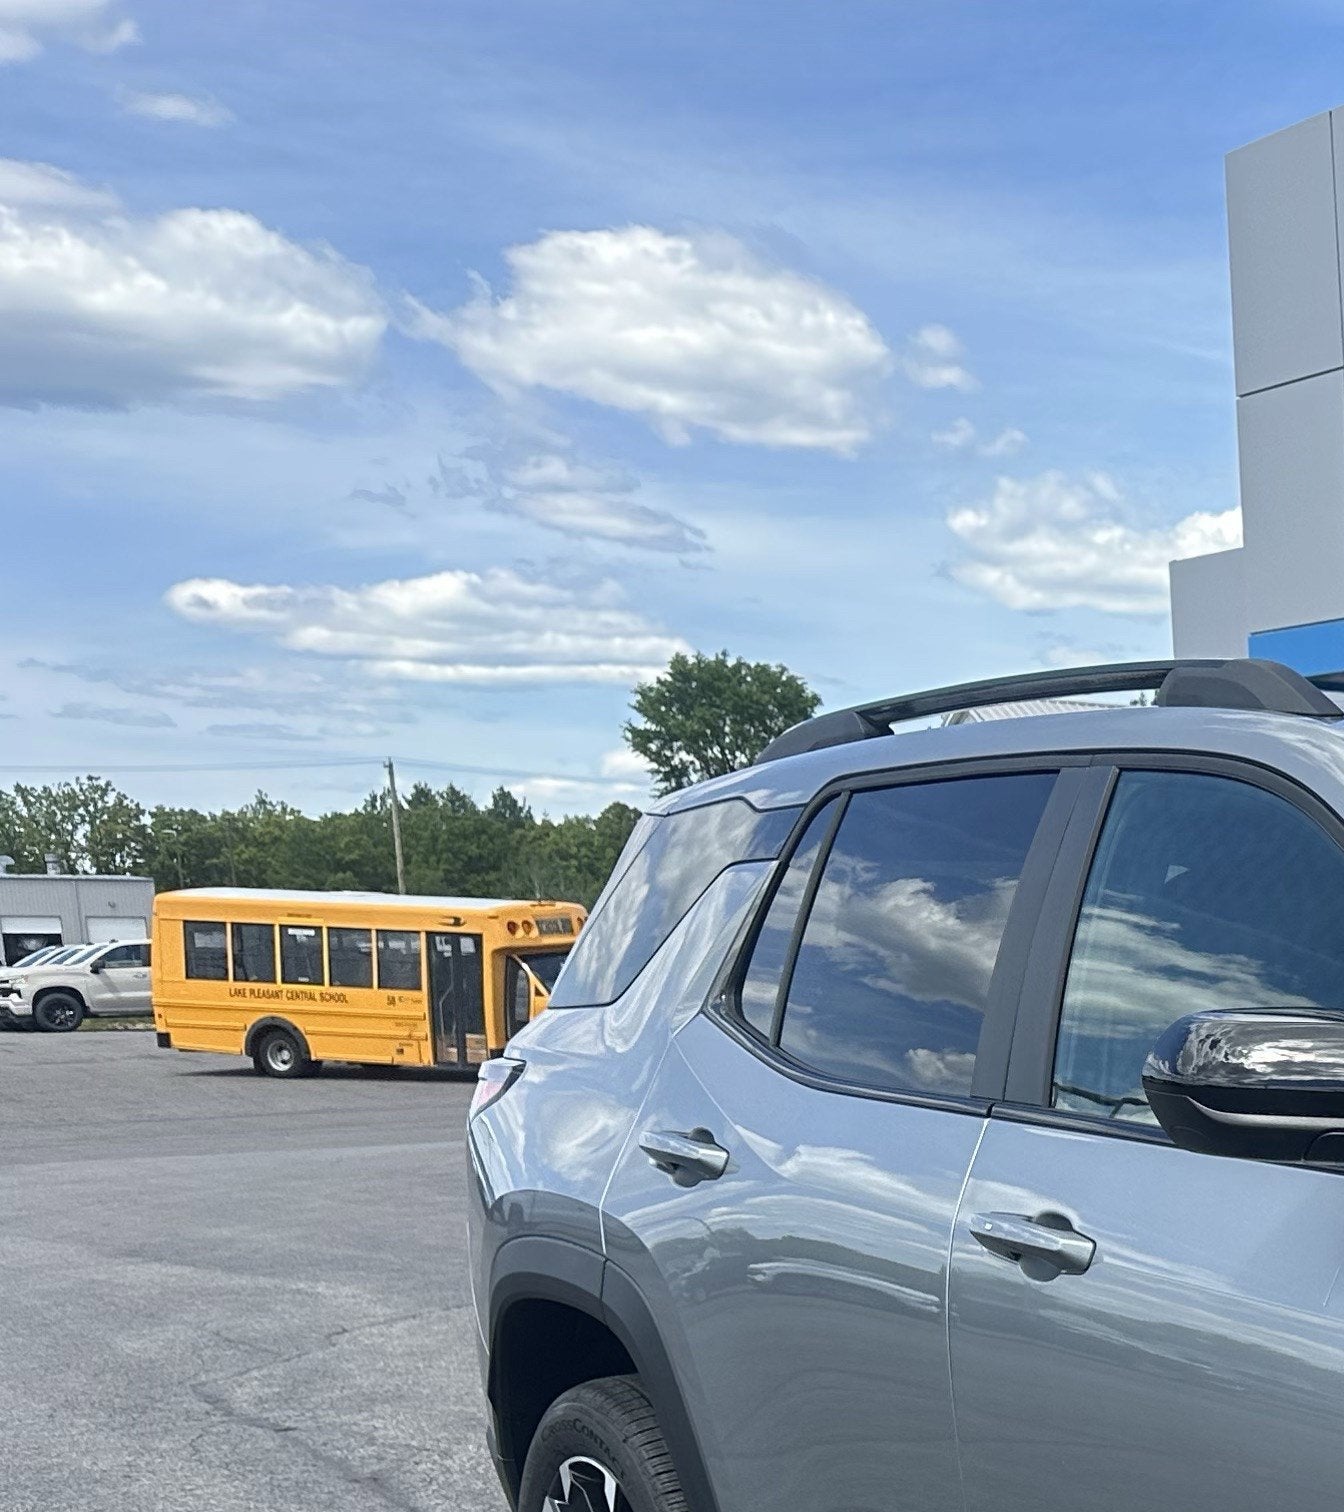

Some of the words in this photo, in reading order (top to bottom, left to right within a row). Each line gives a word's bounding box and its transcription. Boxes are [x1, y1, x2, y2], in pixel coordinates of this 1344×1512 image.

[229, 987, 248, 999] LAKE
[249, 988, 284, 1001] PLEASANT
[286, 989, 317, 1002] CENTRAL
[319, 991, 349, 1004] SCHOOL
